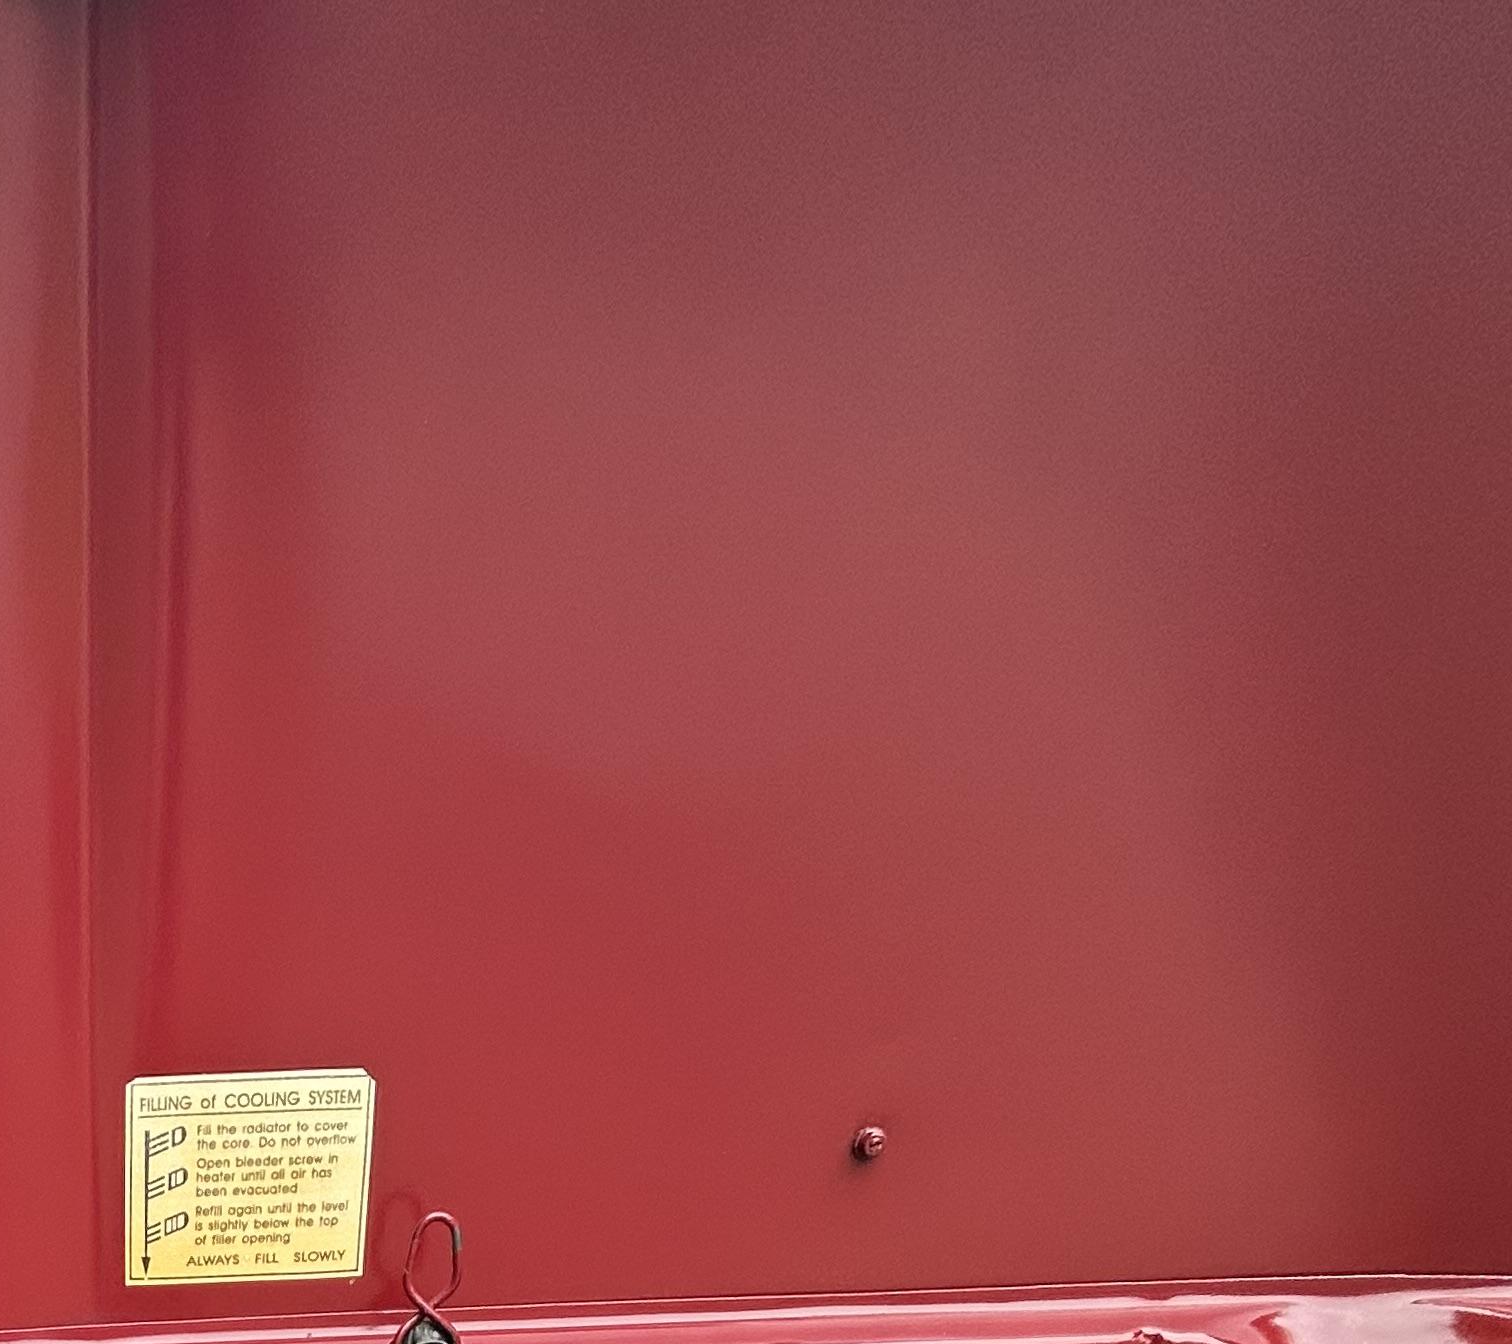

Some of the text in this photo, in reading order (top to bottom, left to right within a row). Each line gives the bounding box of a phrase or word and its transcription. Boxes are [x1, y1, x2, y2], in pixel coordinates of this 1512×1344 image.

[140, 1089, 361, 1112] FILLING of COOLING SYSTEM
[197, 1121, 348, 1136] Fill the radiator to cover
[197, 1139, 216, 1151] the
[259, 1136, 276, 1148] Do
[281, 1135, 301, 1147] not
[307, 1134, 356, 1147] overflow
[197, 1153, 338, 1170] Open bleeder screw in
[196, 1168, 332, 1183] heater until all air has
[196, 1183, 298, 1197] been evacuated
[195, 1200, 349, 1217] Refill again until the level
[195, 1216, 338, 1232] is slightly below the top
[195, 1232, 290, 1245] of filler opening
[186, 1250, 346, 1267] ALWAYS FILL SLOWLY
